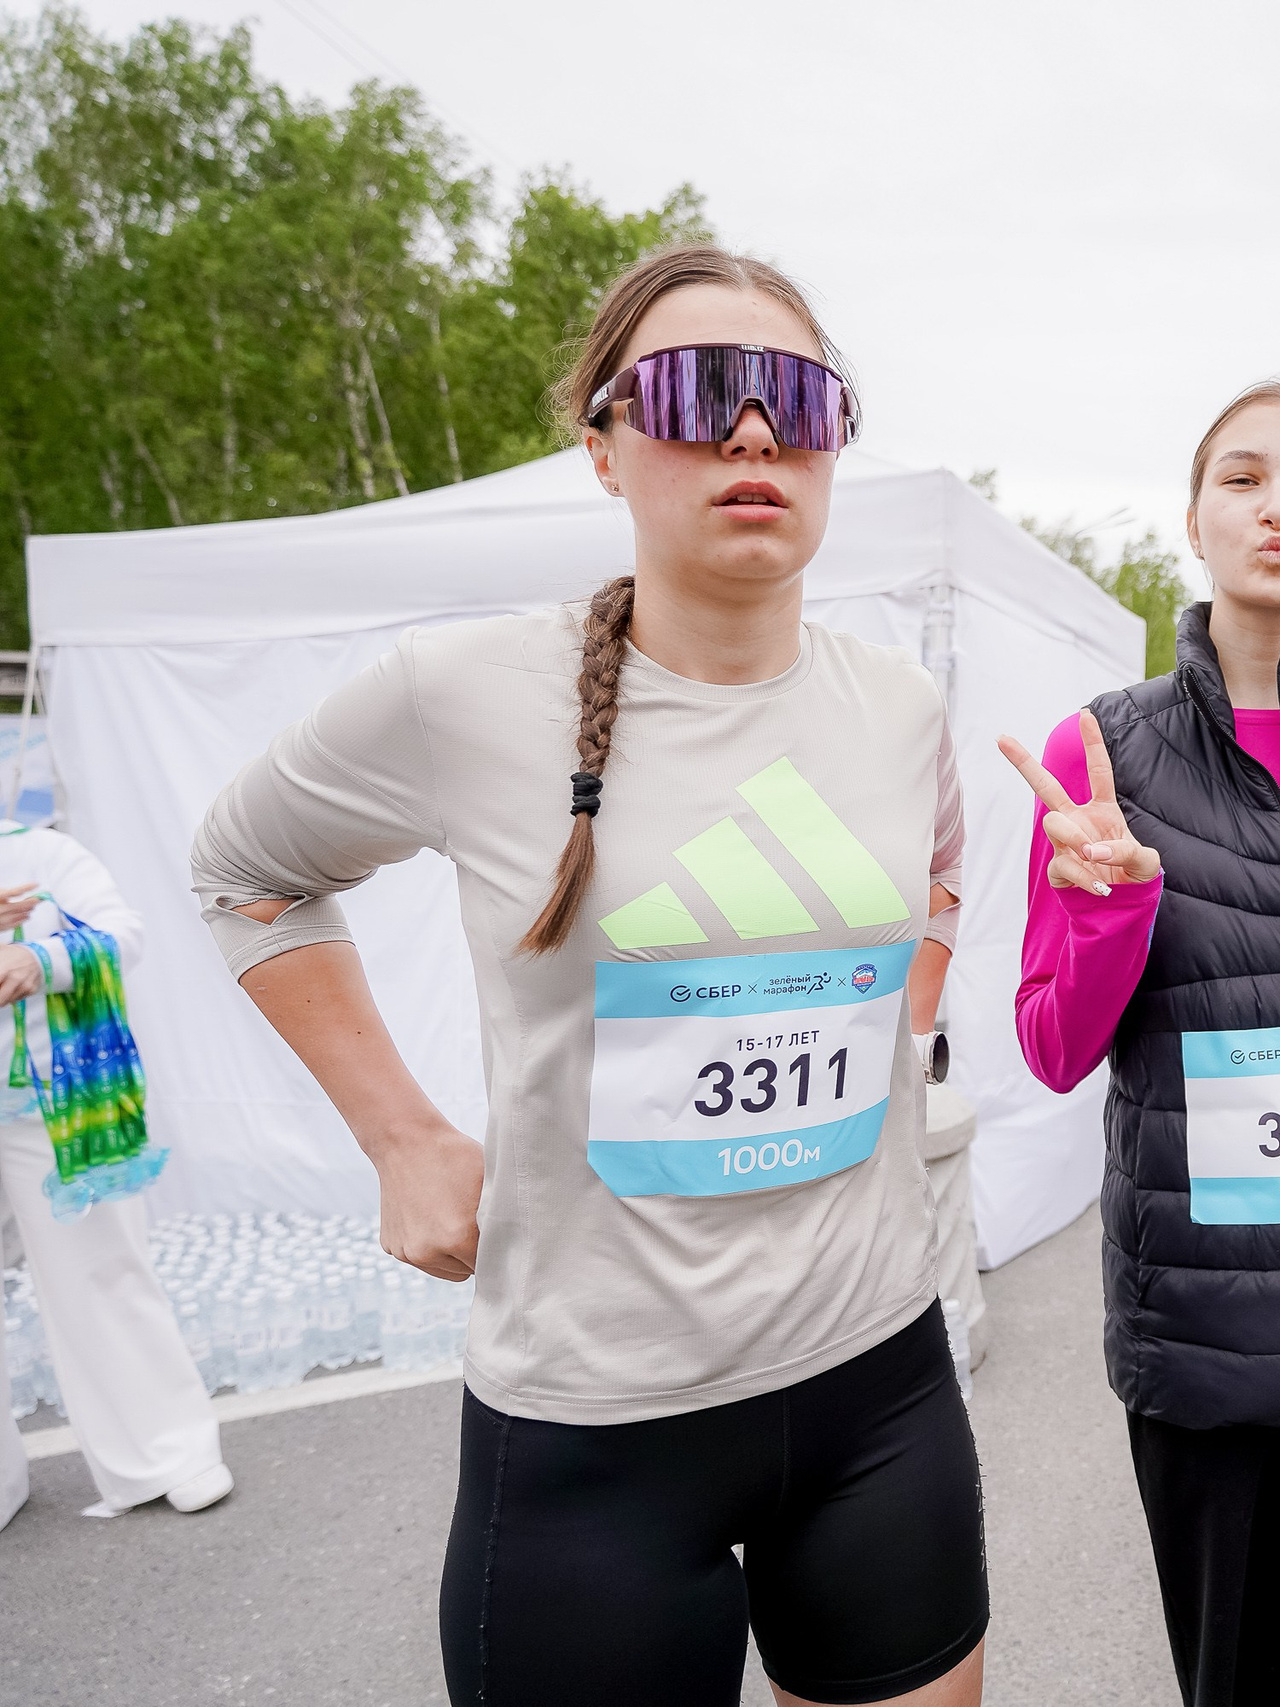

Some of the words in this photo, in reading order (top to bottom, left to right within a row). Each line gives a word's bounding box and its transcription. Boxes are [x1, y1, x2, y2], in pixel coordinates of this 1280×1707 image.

[769, 973, 812, 986] зелёный
[696, 984, 742, 999] СБЕР
[763, 983, 807, 996] марафон
[736, 1033, 784, 1051] 15-17
[788, 1030, 820, 1047] ЛЕТ
[694, 1047, 849, 1117] 3311
